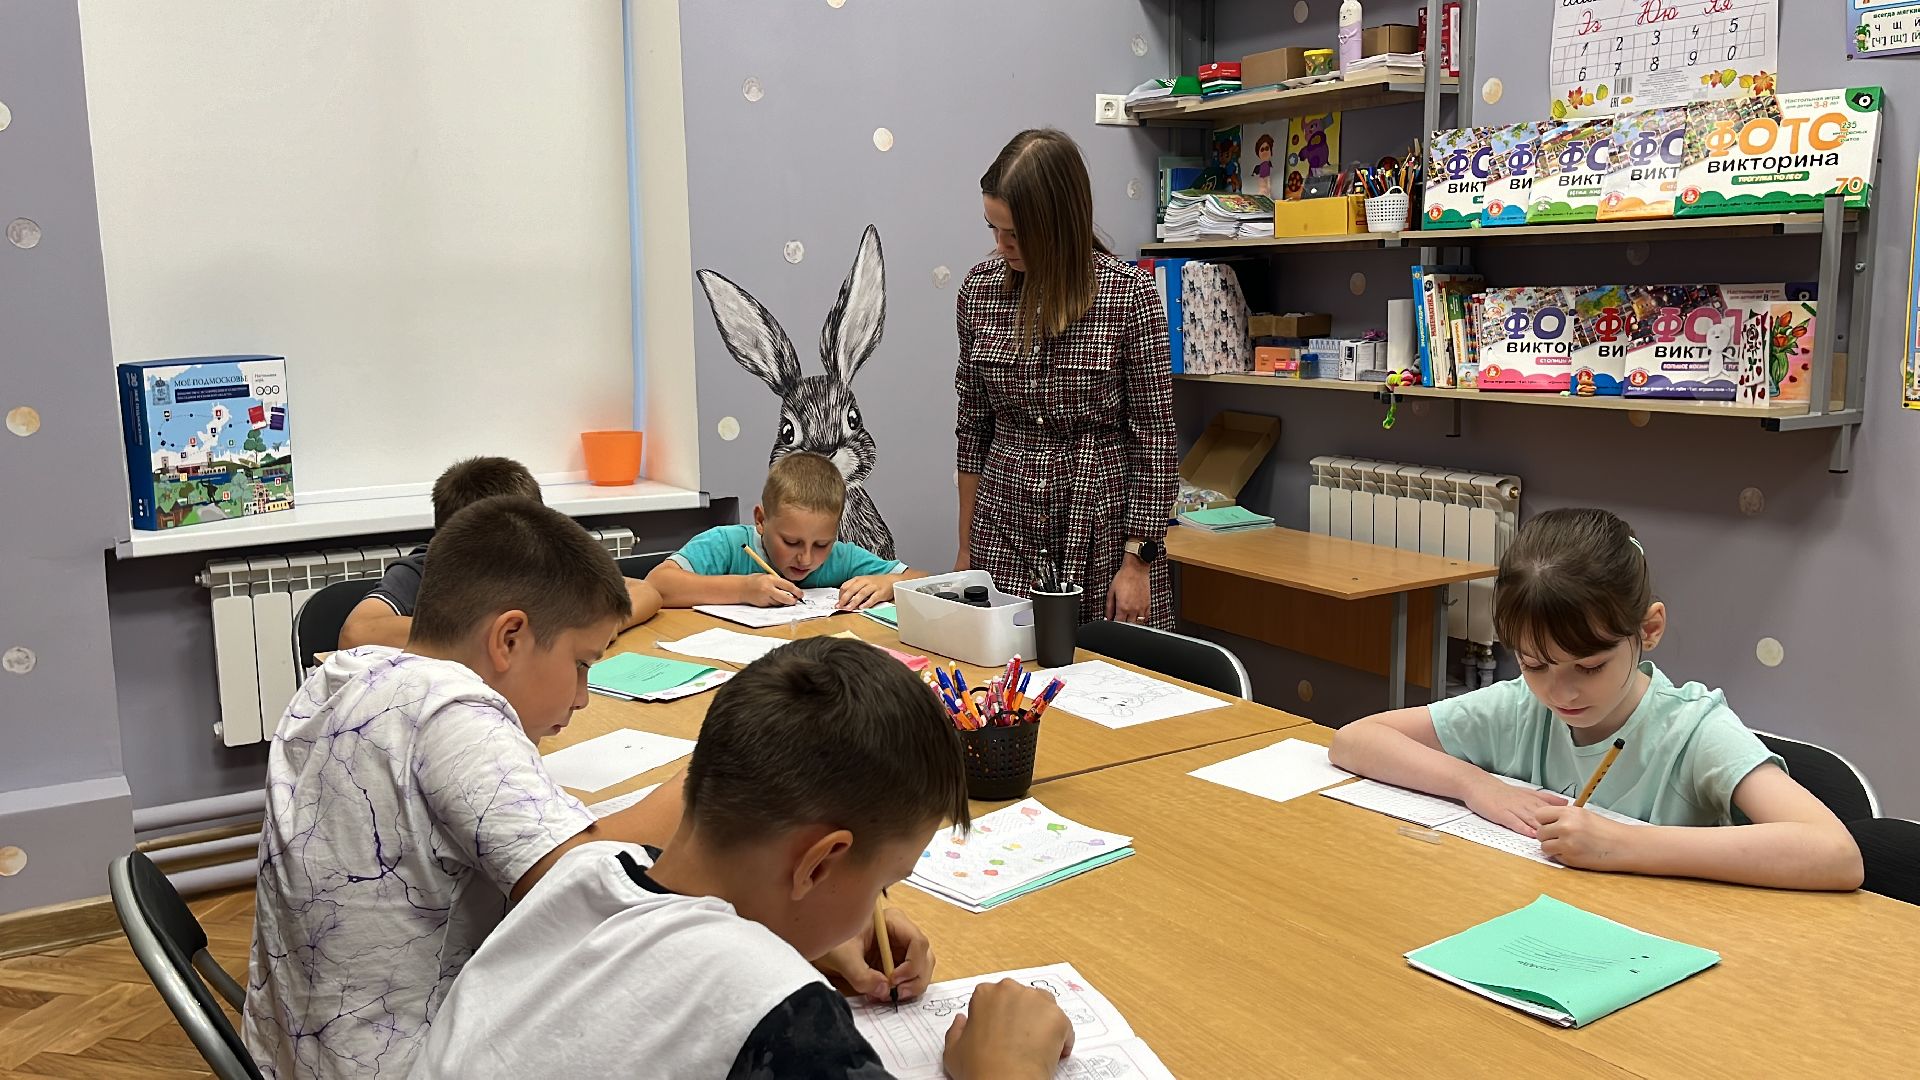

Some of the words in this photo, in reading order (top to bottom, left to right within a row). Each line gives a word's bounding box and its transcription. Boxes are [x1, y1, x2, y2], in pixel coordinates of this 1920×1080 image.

[1581, 42, 1589, 56] 1
[1615, 37, 1624, 51] 2
[1651, 30, 1661, 45] 3
[1692, 24, 1700, 39] 4
[1729, 17, 1739, 32] 5
[1578, 66, 1587, 81] 6
[1614, 62, 1622, 76] 7
[1650, 57, 1659, 71] 8
[1688, 50, 1697, 66] 9
[1727, 45, 1736, 60] 0
[1508, 143, 1538, 176] Ф
[1707, 152, 1839, 173] викторина
[1835, 176, 1864, 194] 70
[1427, 292, 1437, 337] МАТЕМАТИКА
[1503, 306, 1576, 340] ФО
[1595, 307, 1633, 342] Ф
[1598, 345, 1628, 358] ви
